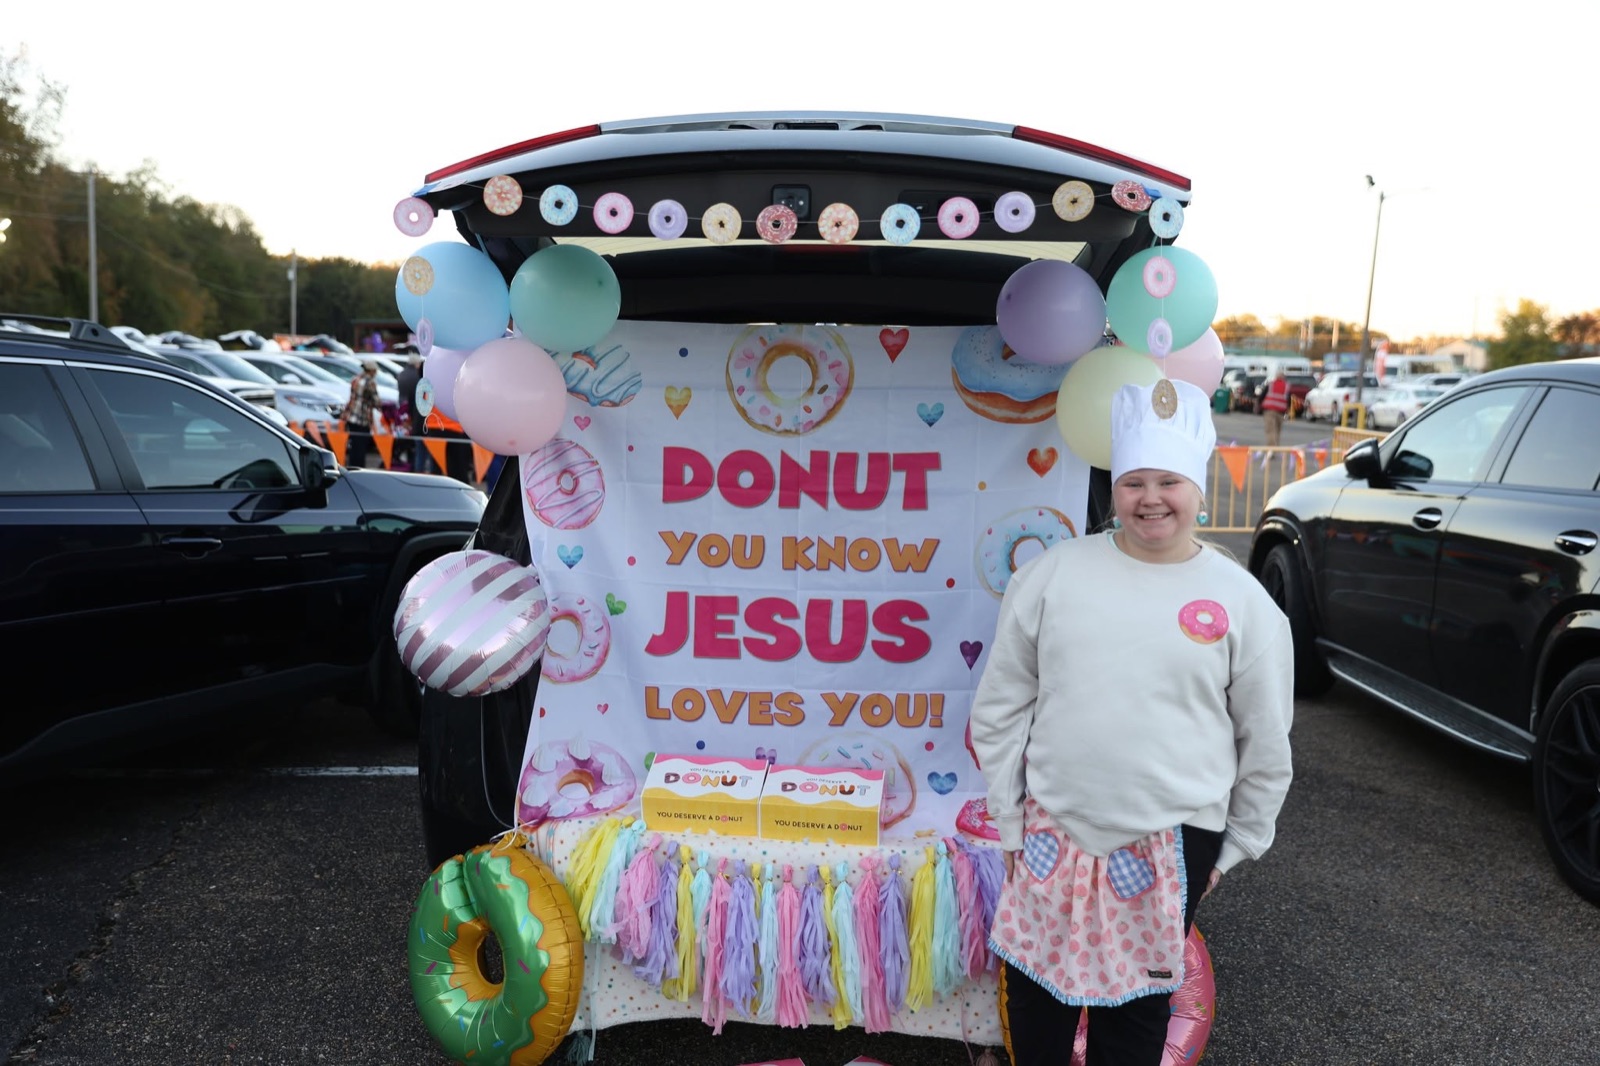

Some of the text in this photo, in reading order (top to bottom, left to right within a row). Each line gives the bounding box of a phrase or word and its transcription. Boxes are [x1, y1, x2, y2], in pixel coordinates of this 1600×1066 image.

[662, 446, 942, 511] DONUT
[658, 530, 940, 573] YOU KNOW
[644, 591, 932, 663] JESUS
[644, 685, 945, 729] LOVES YOU!
[664, 772, 753, 788] DONUT
[781, 781, 871, 796] DONUT
[673, 812, 706, 820] DESERVE
[792, 821, 825, 829] DESERVE
[834, 822, 863, 831] DONUT
